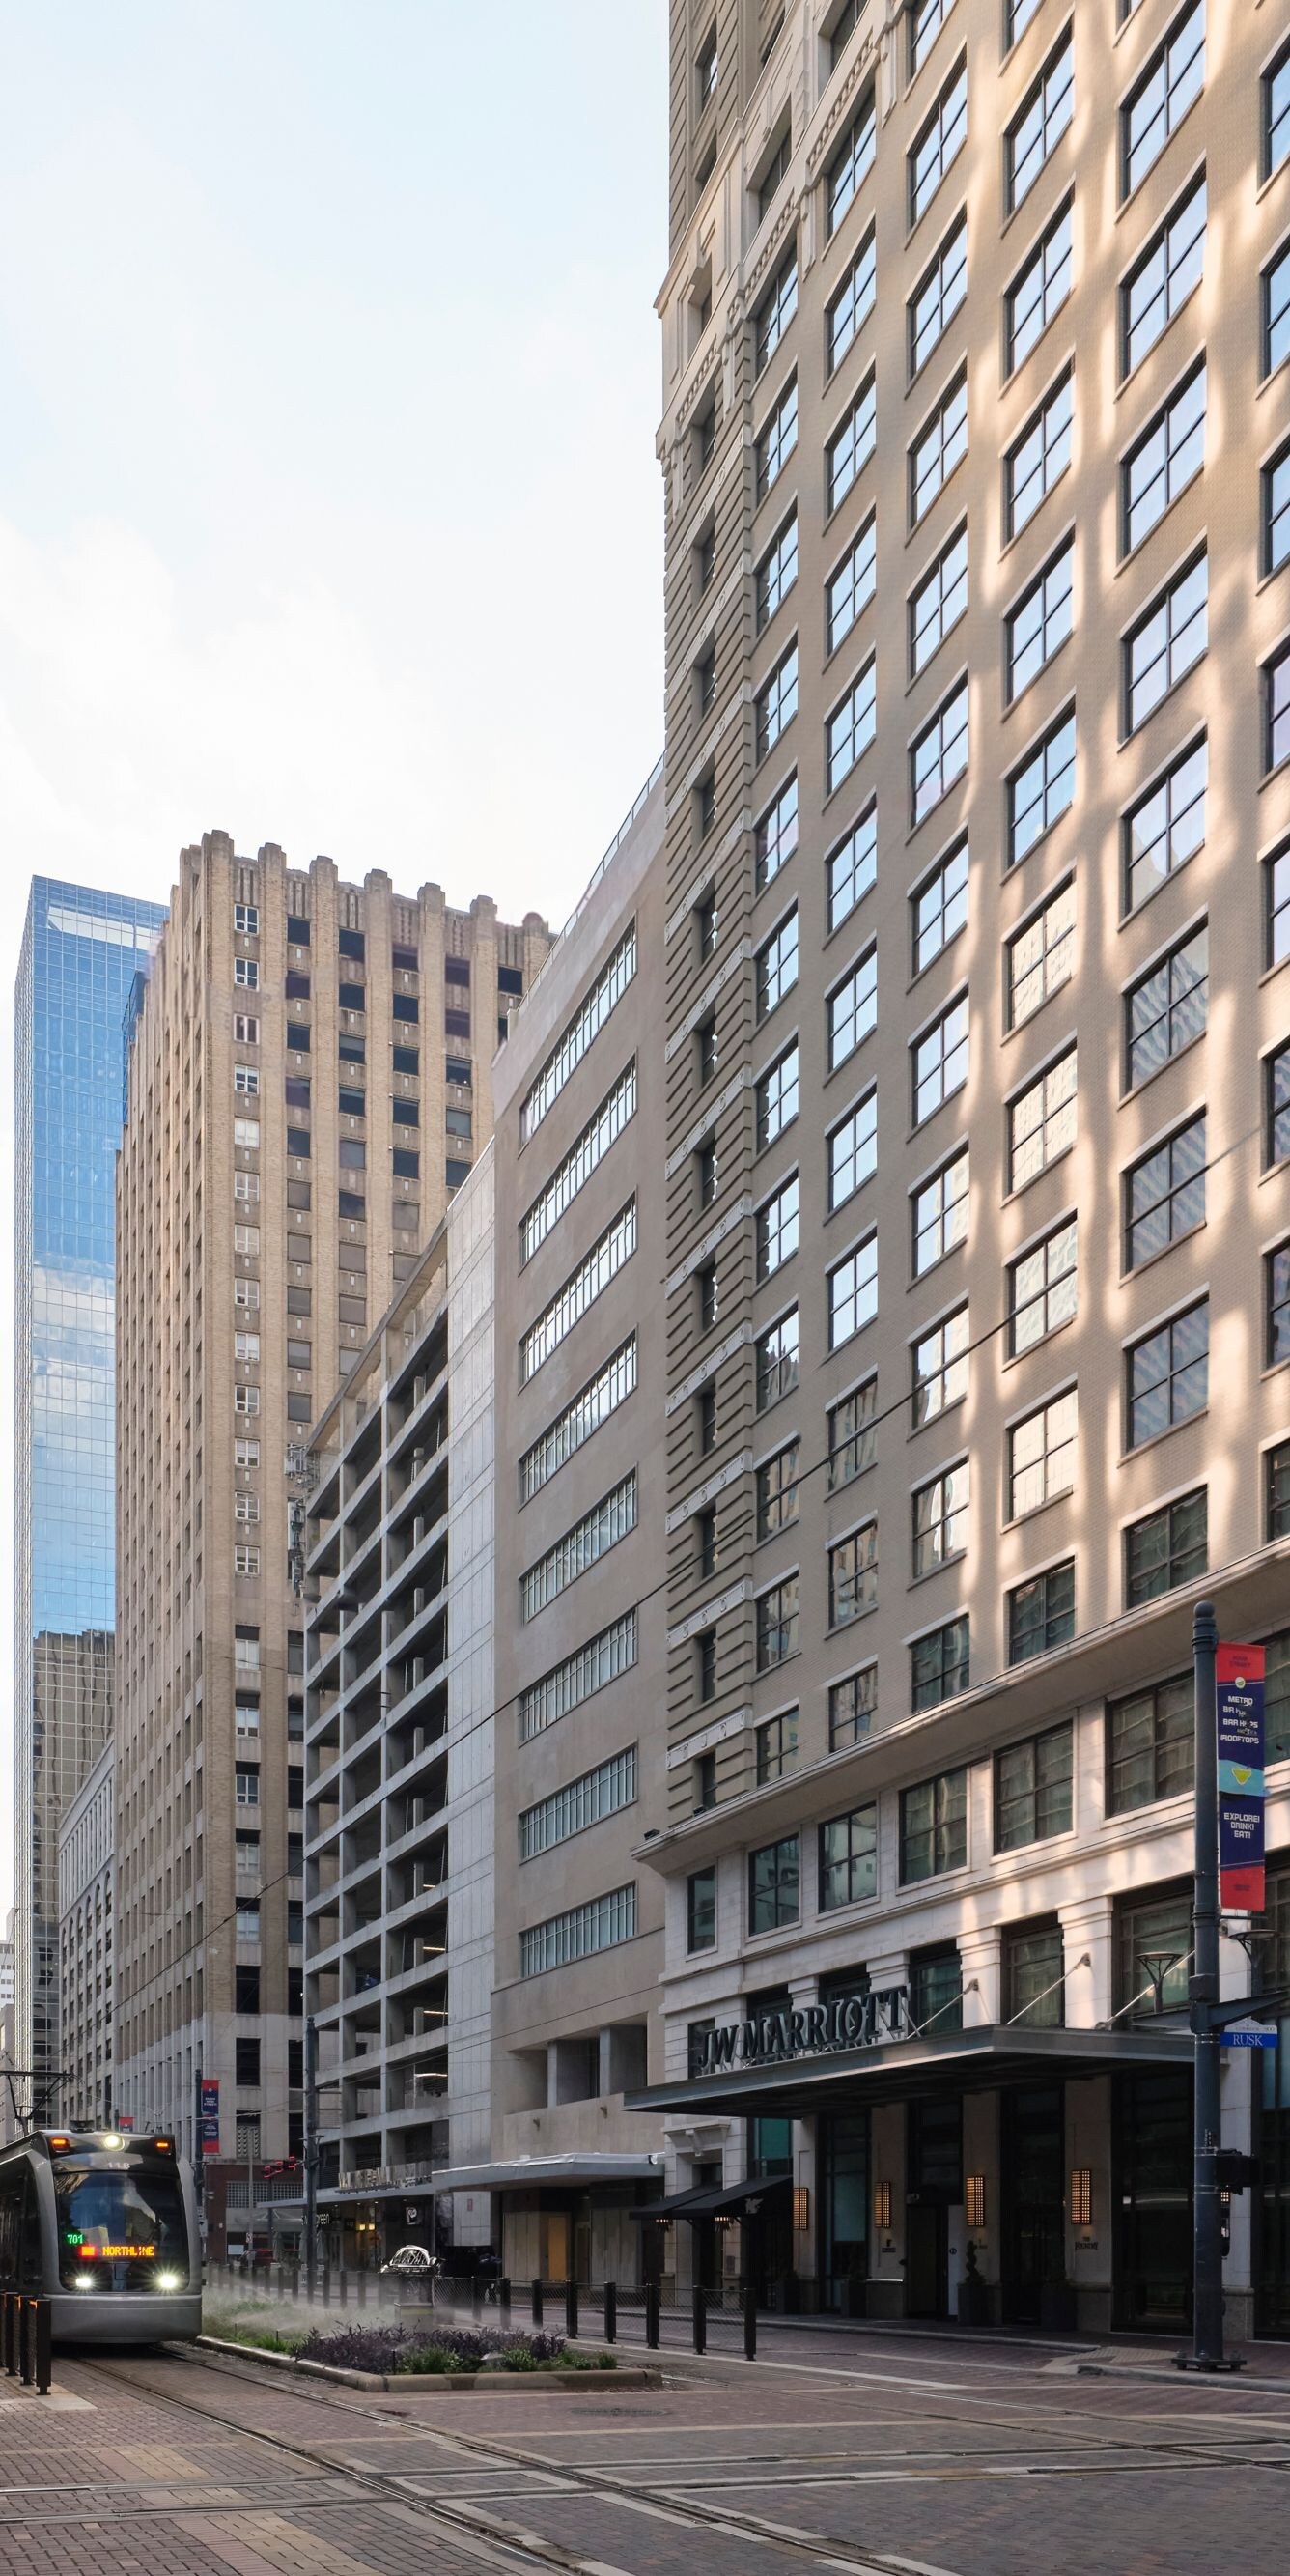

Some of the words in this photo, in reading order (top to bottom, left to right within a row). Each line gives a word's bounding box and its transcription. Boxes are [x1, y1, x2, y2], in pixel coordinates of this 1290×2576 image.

[1227, 1695, 1253, 1706] METRO
[1223, 1812, 1261, 1823] EXPLORE!
[1230, 1821, 1255, 1831] DRINK!
[1233, 1830, 1251, 1839] EAT!
[697, 2024, 739, 2068] JW
[740, 1984, 911, 2060] MARRIOTT
[1233, 2033, 1263, 2046] RUSK
[67, 2234, 84, 2244] 701
[102, 2246, 154, 2256] NORTHLINE
